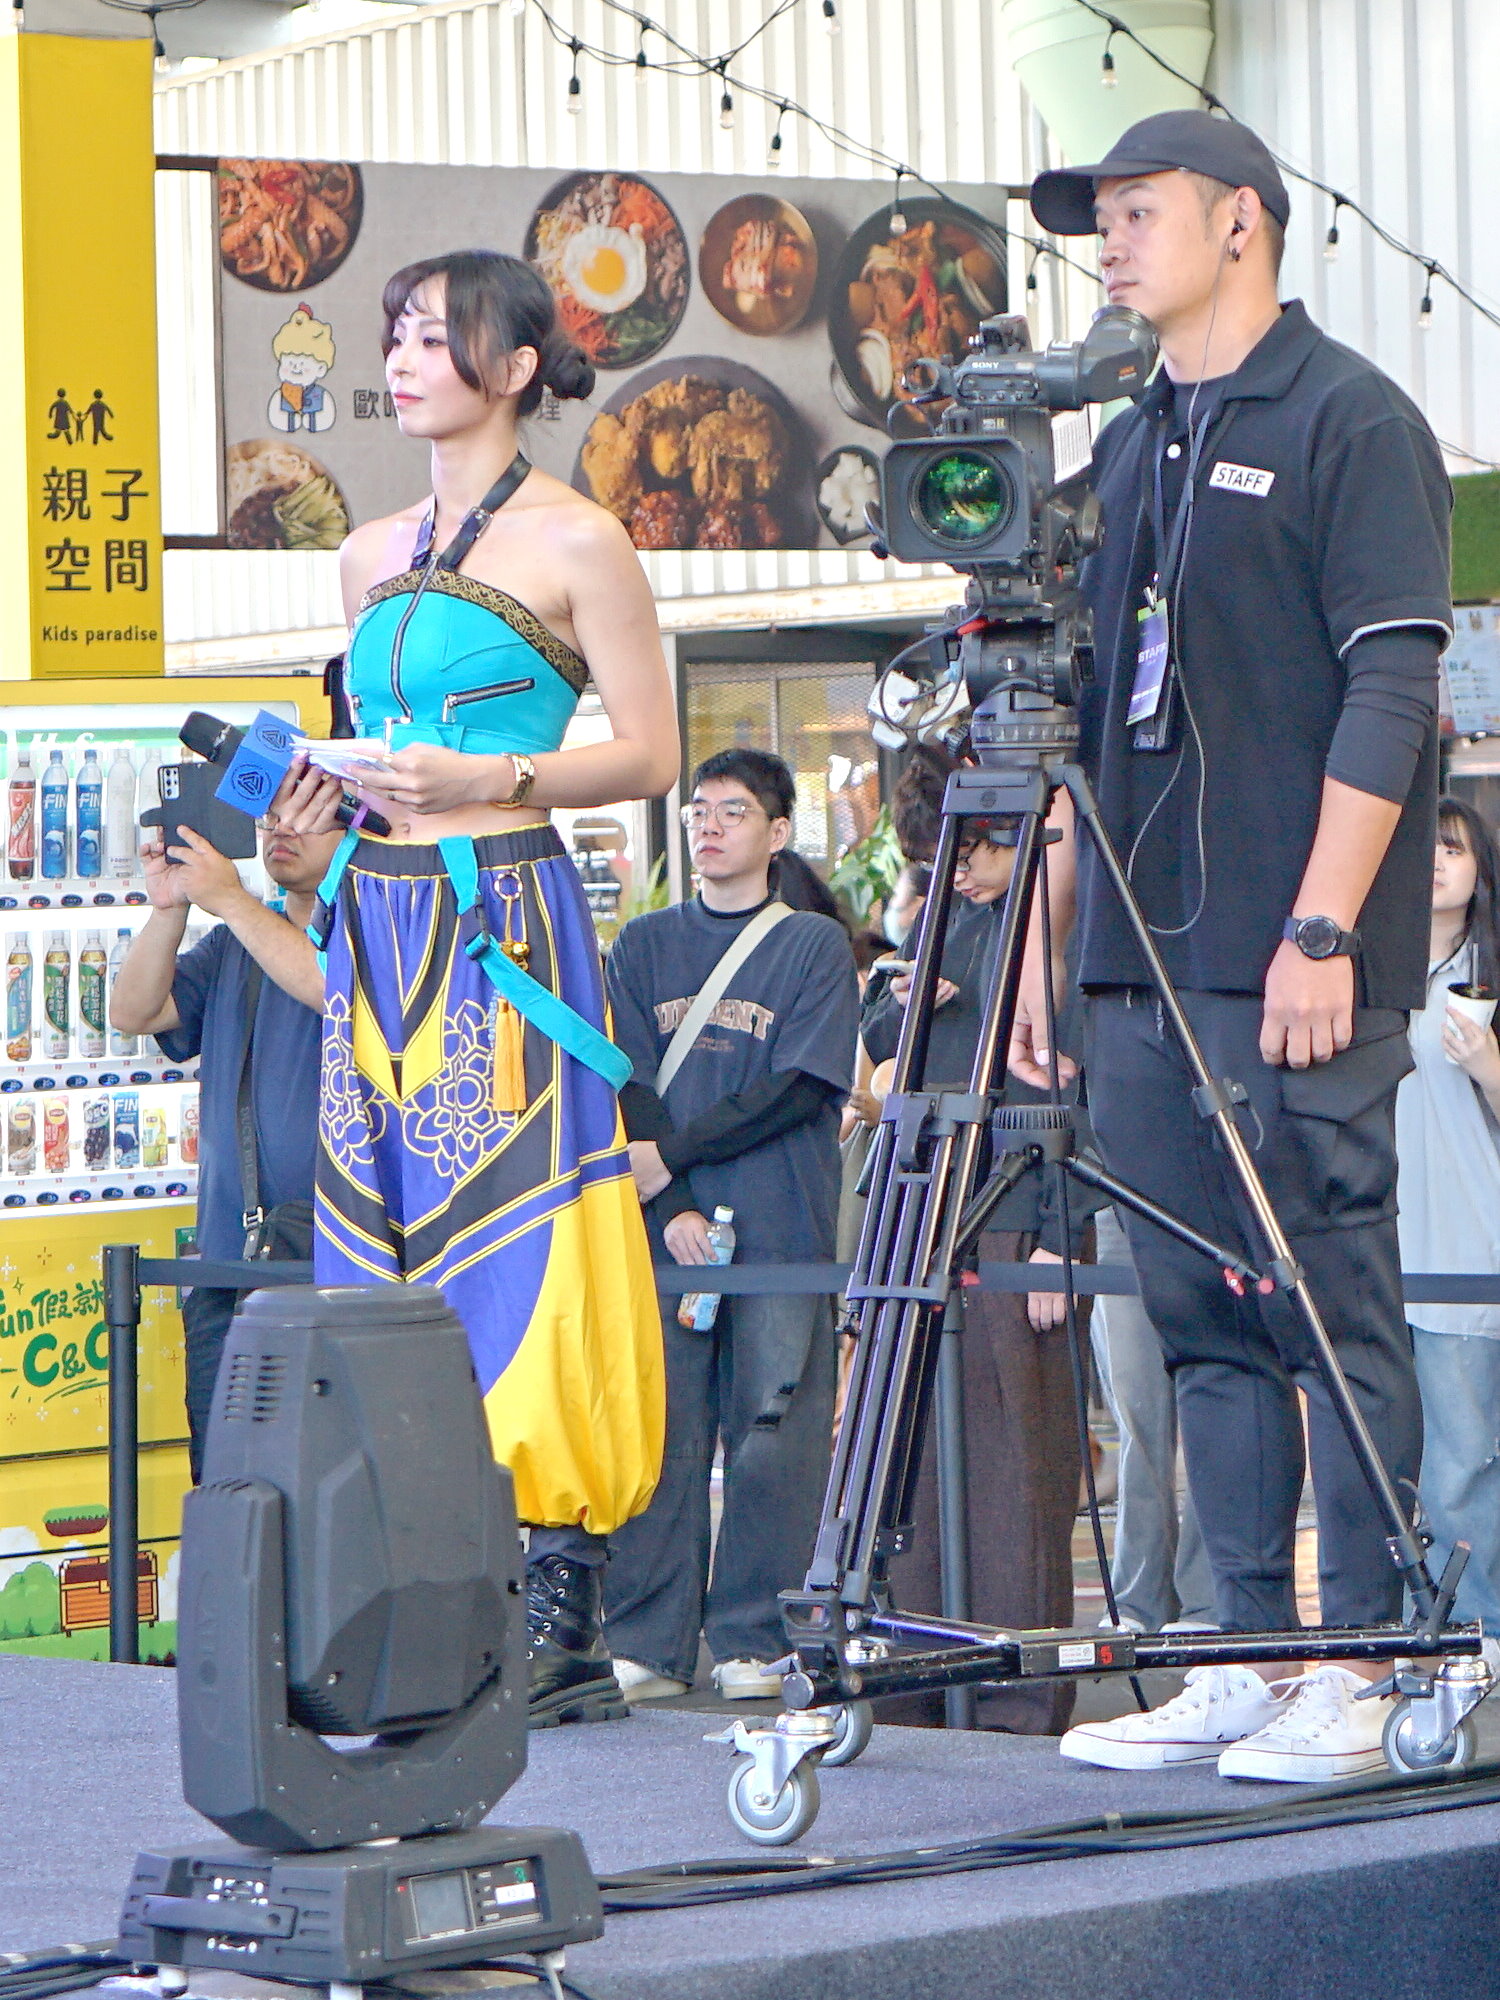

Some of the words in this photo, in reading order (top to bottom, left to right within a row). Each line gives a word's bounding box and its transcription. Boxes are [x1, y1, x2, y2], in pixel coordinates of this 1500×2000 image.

[972, 361, 1000, 369] SONY
[1216, 466, 1266, 490] STAFF
[42, 466, 149, 522] 親子
[45, 537, 149, 593] 空間
[43, 625, 78, 641] Kids
[86, 625, 158, 646] paradise
[114, 1098, 138, 1112] FIN
